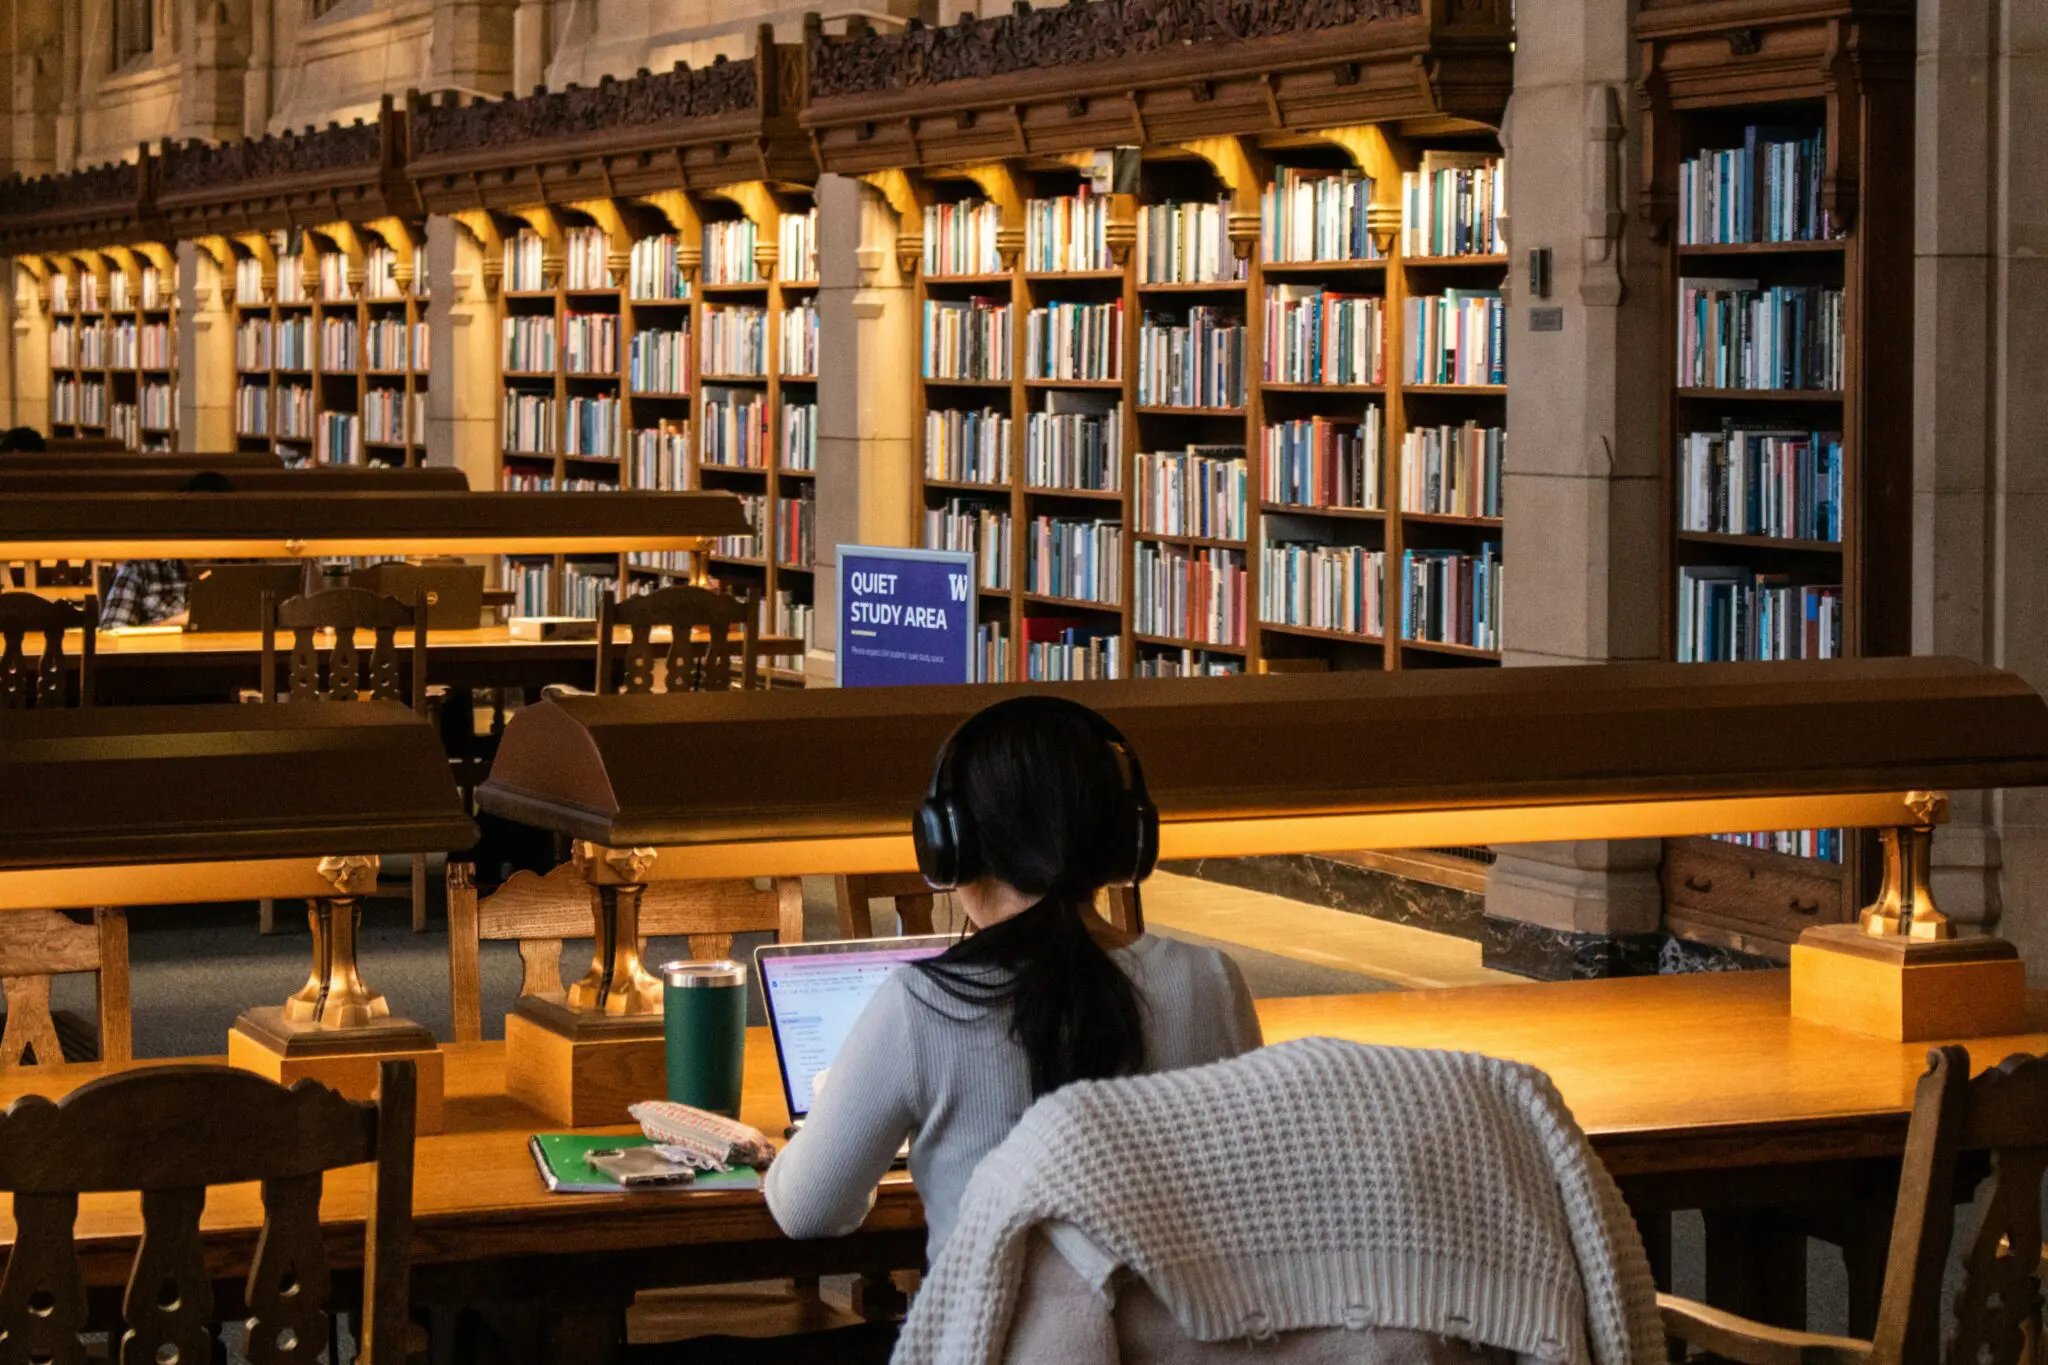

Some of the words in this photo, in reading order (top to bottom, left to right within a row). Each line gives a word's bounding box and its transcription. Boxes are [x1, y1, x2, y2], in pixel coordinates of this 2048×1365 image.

[851, 571, 897, 596] QUIET
[948, 573, 968, 602] W
[851, 602, 902, 625] STUDY
[904, 606, 948, 630] AREA
